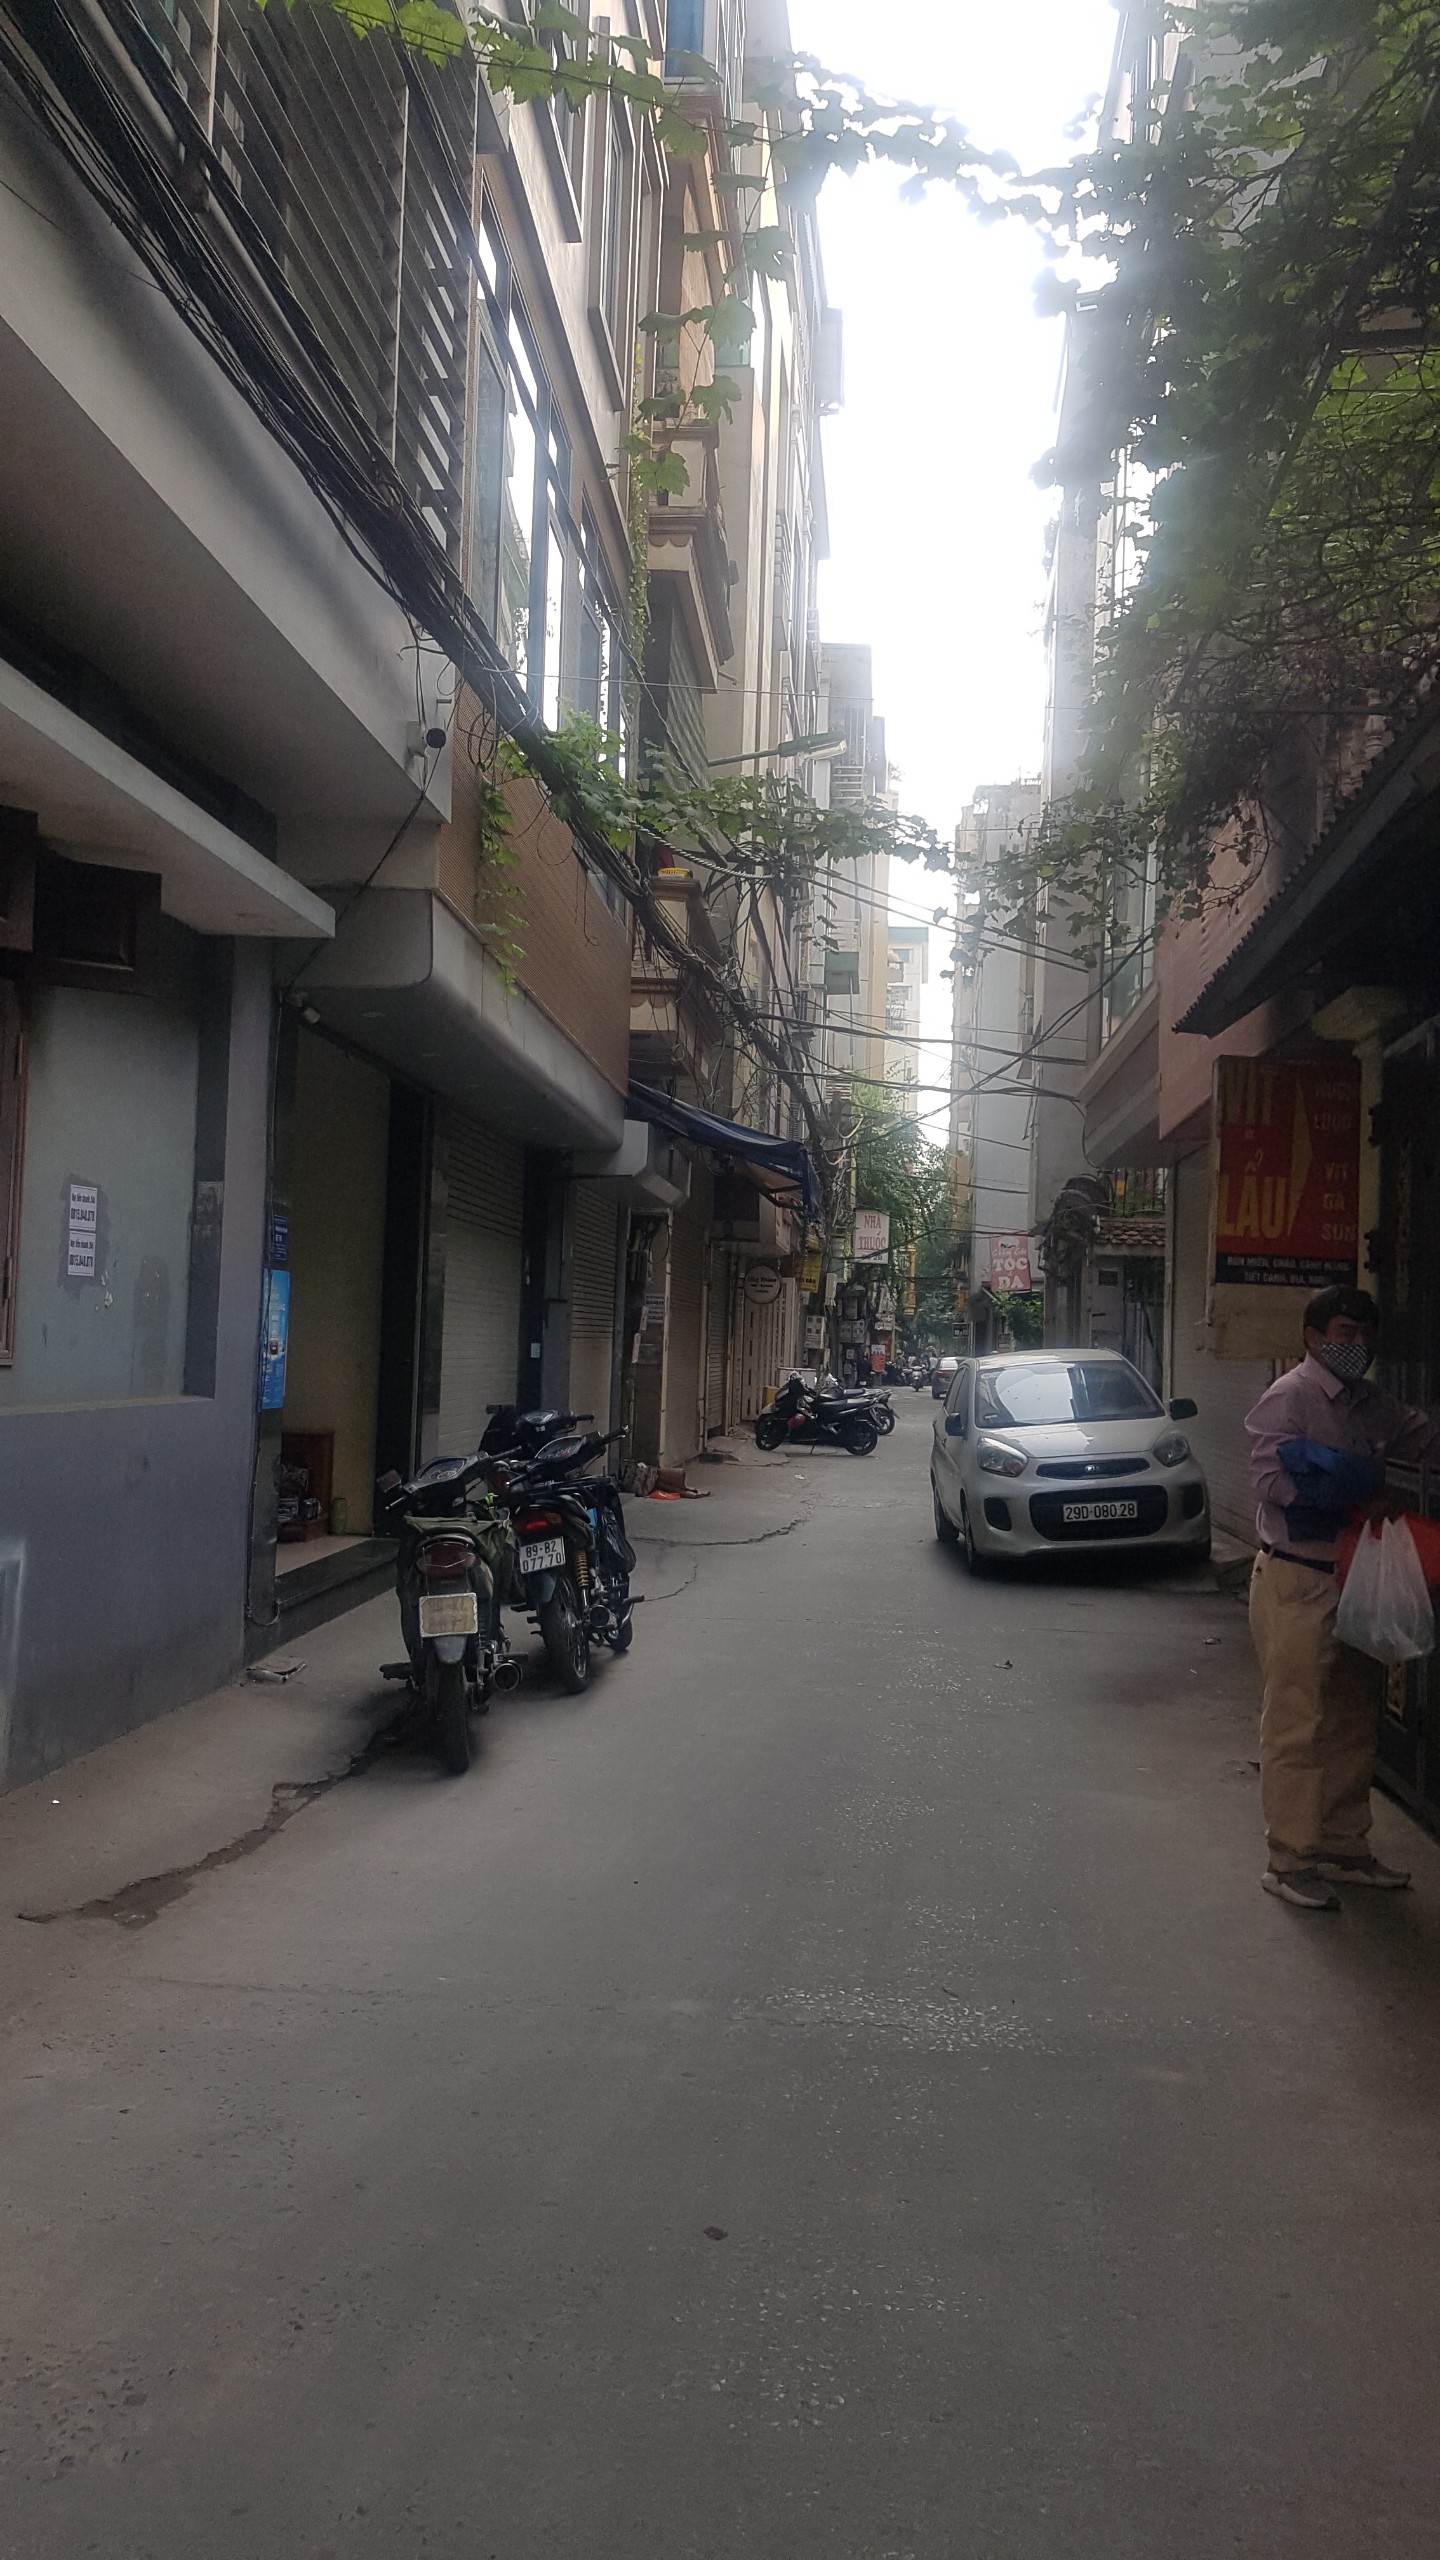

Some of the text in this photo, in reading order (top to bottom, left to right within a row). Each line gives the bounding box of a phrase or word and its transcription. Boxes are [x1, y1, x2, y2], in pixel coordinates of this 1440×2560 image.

[1217, 1148, 1287, 1239] LẨU
[863, 1213, 882, 1229] NHÀ
[858, 1231, 887, 1249] THUỐC
[992, 1255, 1028, 1272] TÓC
[998, 1275, 1025, 1290] DA
[1065, 1503, 1135, 1520] 29D-080.28
[523, 1552, 562, 1572] 077.70
